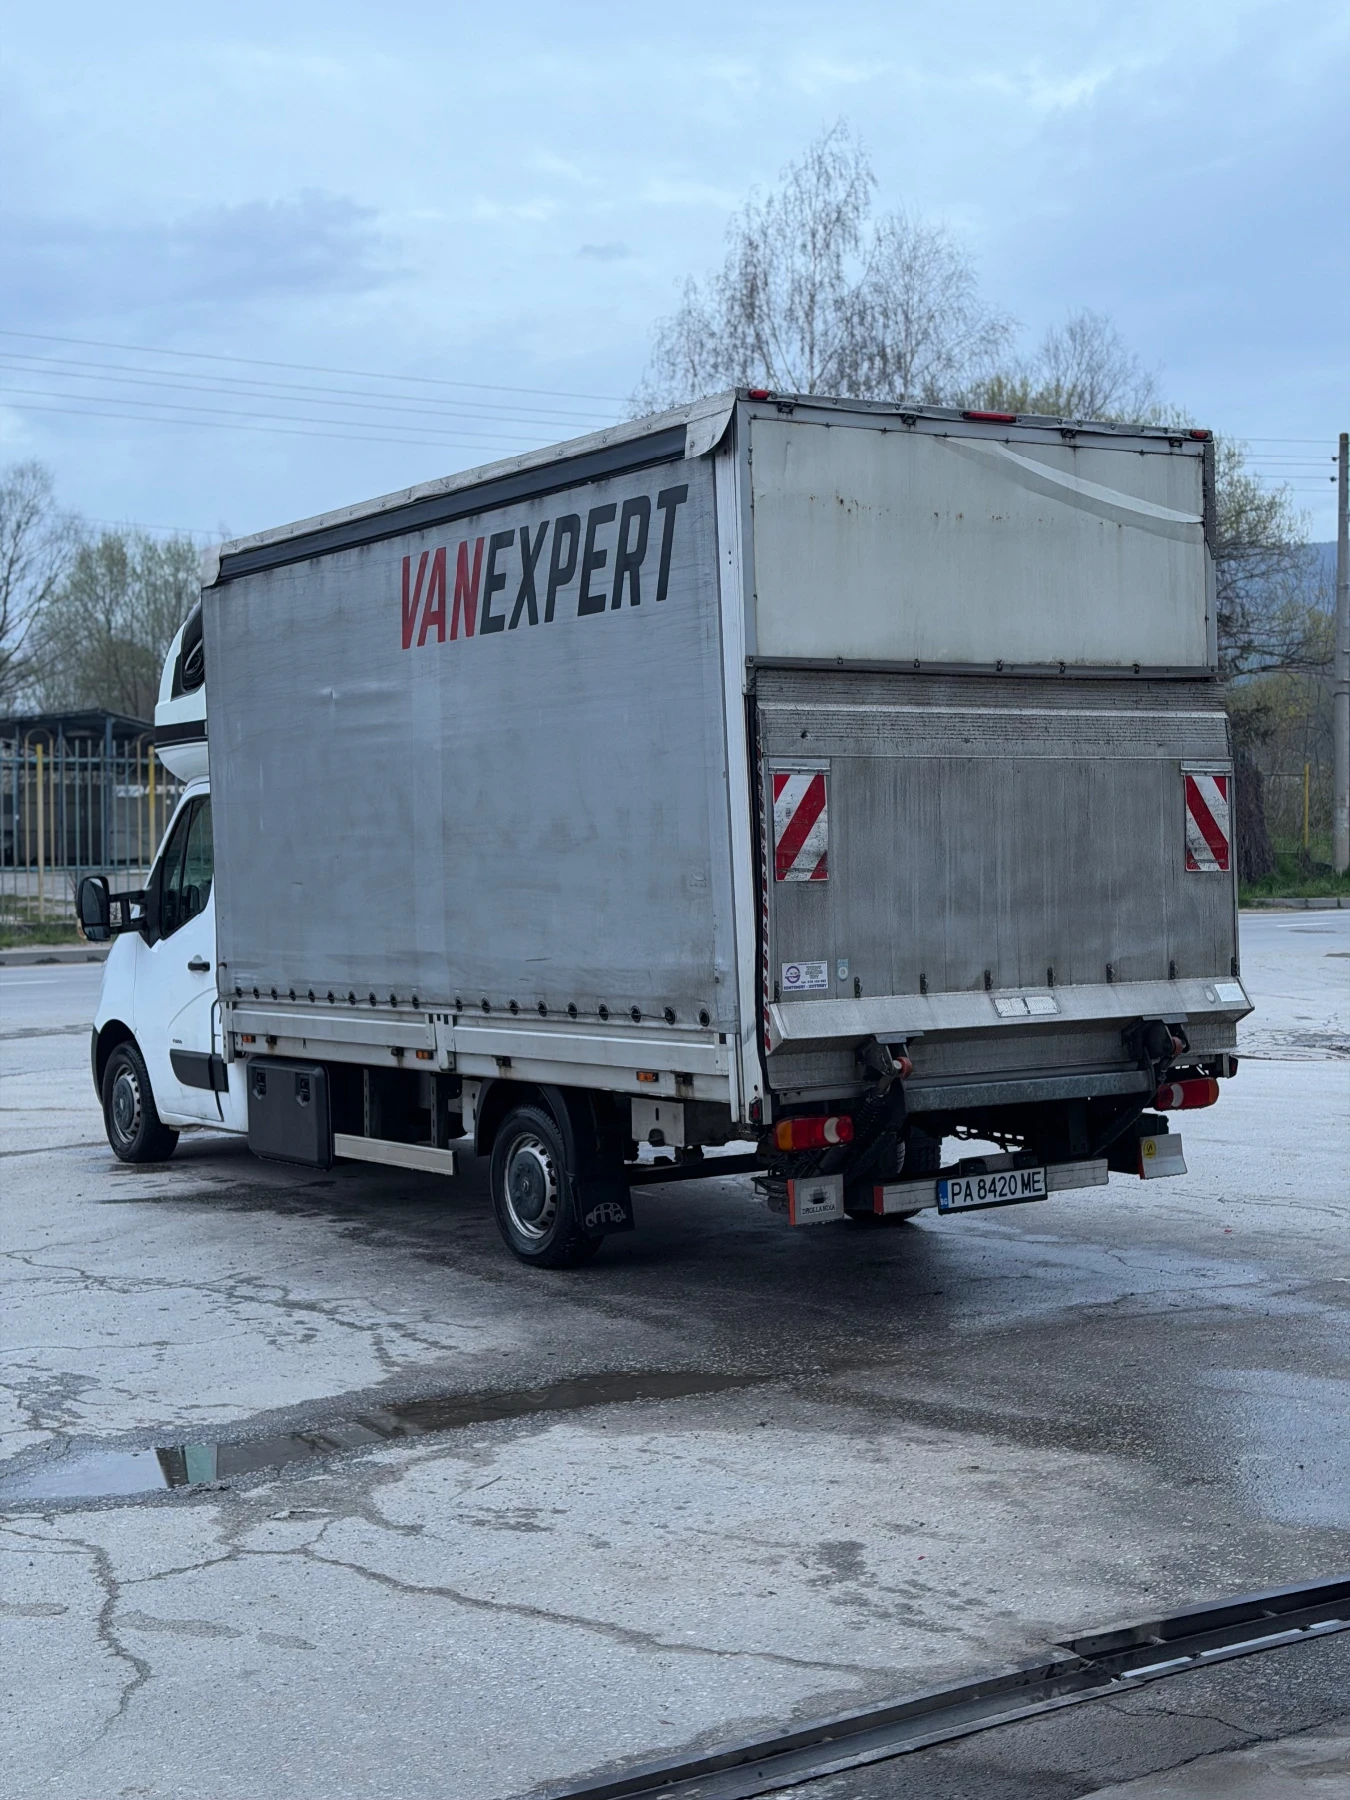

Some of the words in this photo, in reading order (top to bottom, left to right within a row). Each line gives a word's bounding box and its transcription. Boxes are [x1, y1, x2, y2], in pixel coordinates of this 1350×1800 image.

[401, 483, 689, 649] VANEXPERT
[951, 1180, 973, 1204] PA
[977, 1174, 1017, 1200] 8420
[1021, 1171, 1042, 1194] ME
